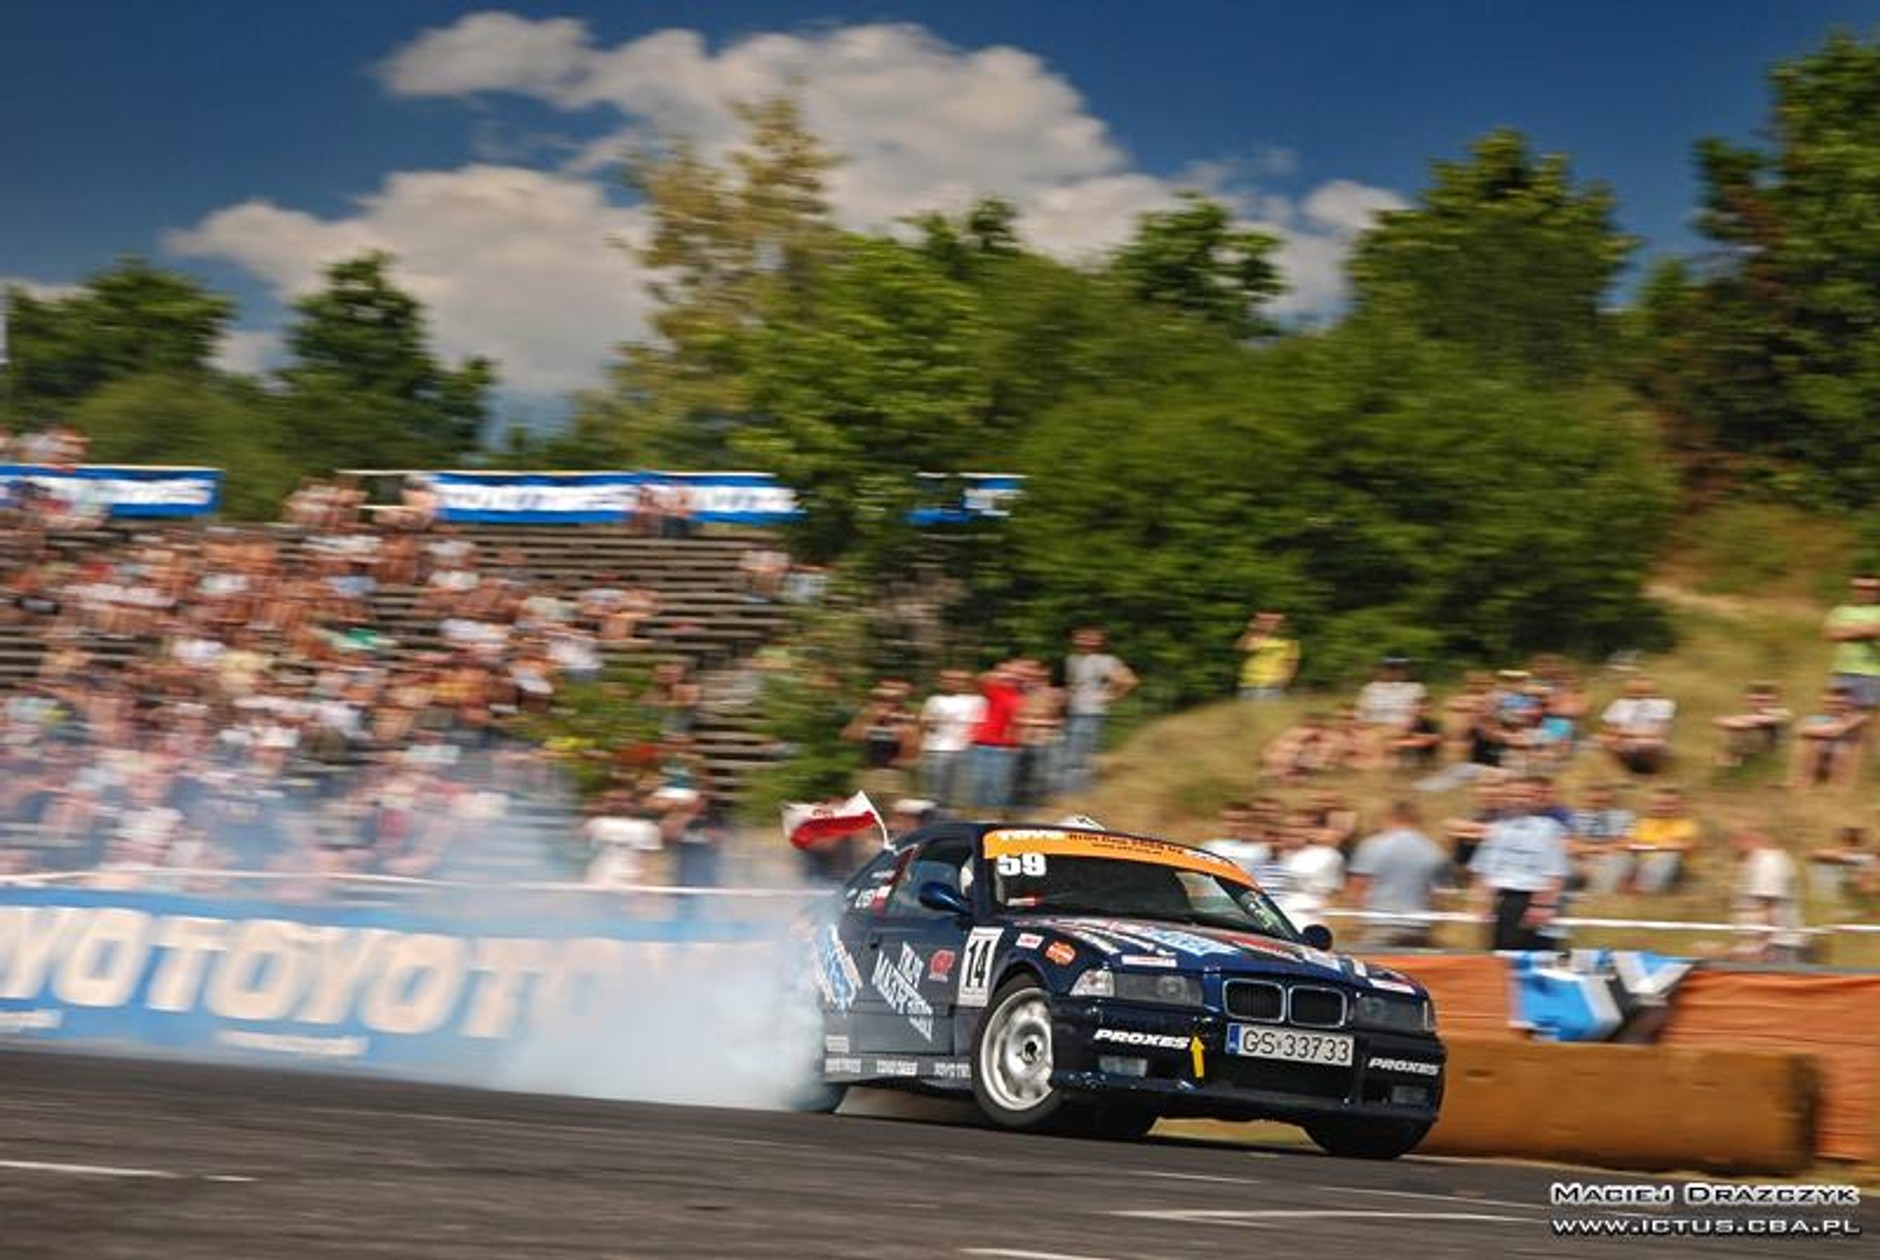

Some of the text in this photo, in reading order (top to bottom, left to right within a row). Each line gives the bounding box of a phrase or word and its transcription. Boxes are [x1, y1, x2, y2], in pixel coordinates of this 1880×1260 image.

[997, 853, 1047, 876] 59
[965, 940, 992, 988] 14
[1094, 1029, 1190, 1049] PROXES
[1369, 1056, 1440, 1077] PROXES
